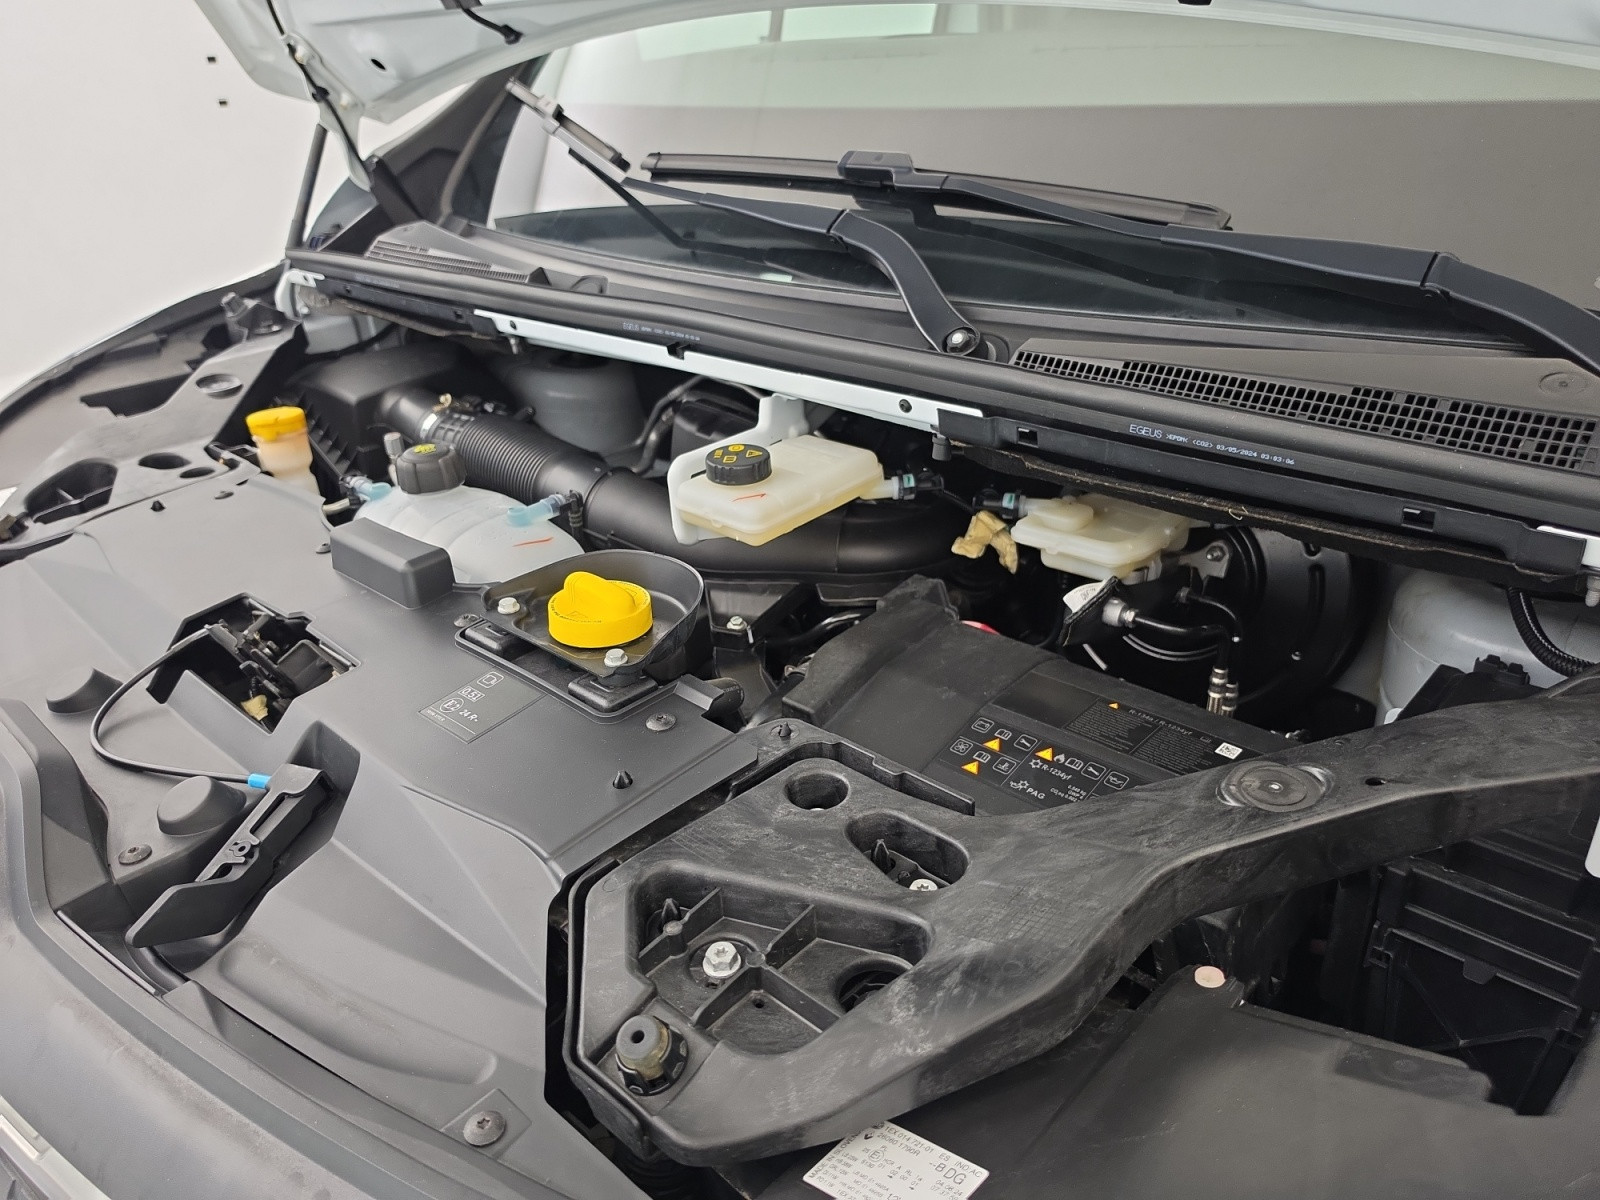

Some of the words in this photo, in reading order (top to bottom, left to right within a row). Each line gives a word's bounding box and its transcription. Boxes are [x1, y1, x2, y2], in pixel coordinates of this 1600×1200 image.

[1129, 424, 1163, 439] EGEUS
[1041, 764, 1073, 781] R-1234yf
[1026, 787, 1046, 800] PAG
